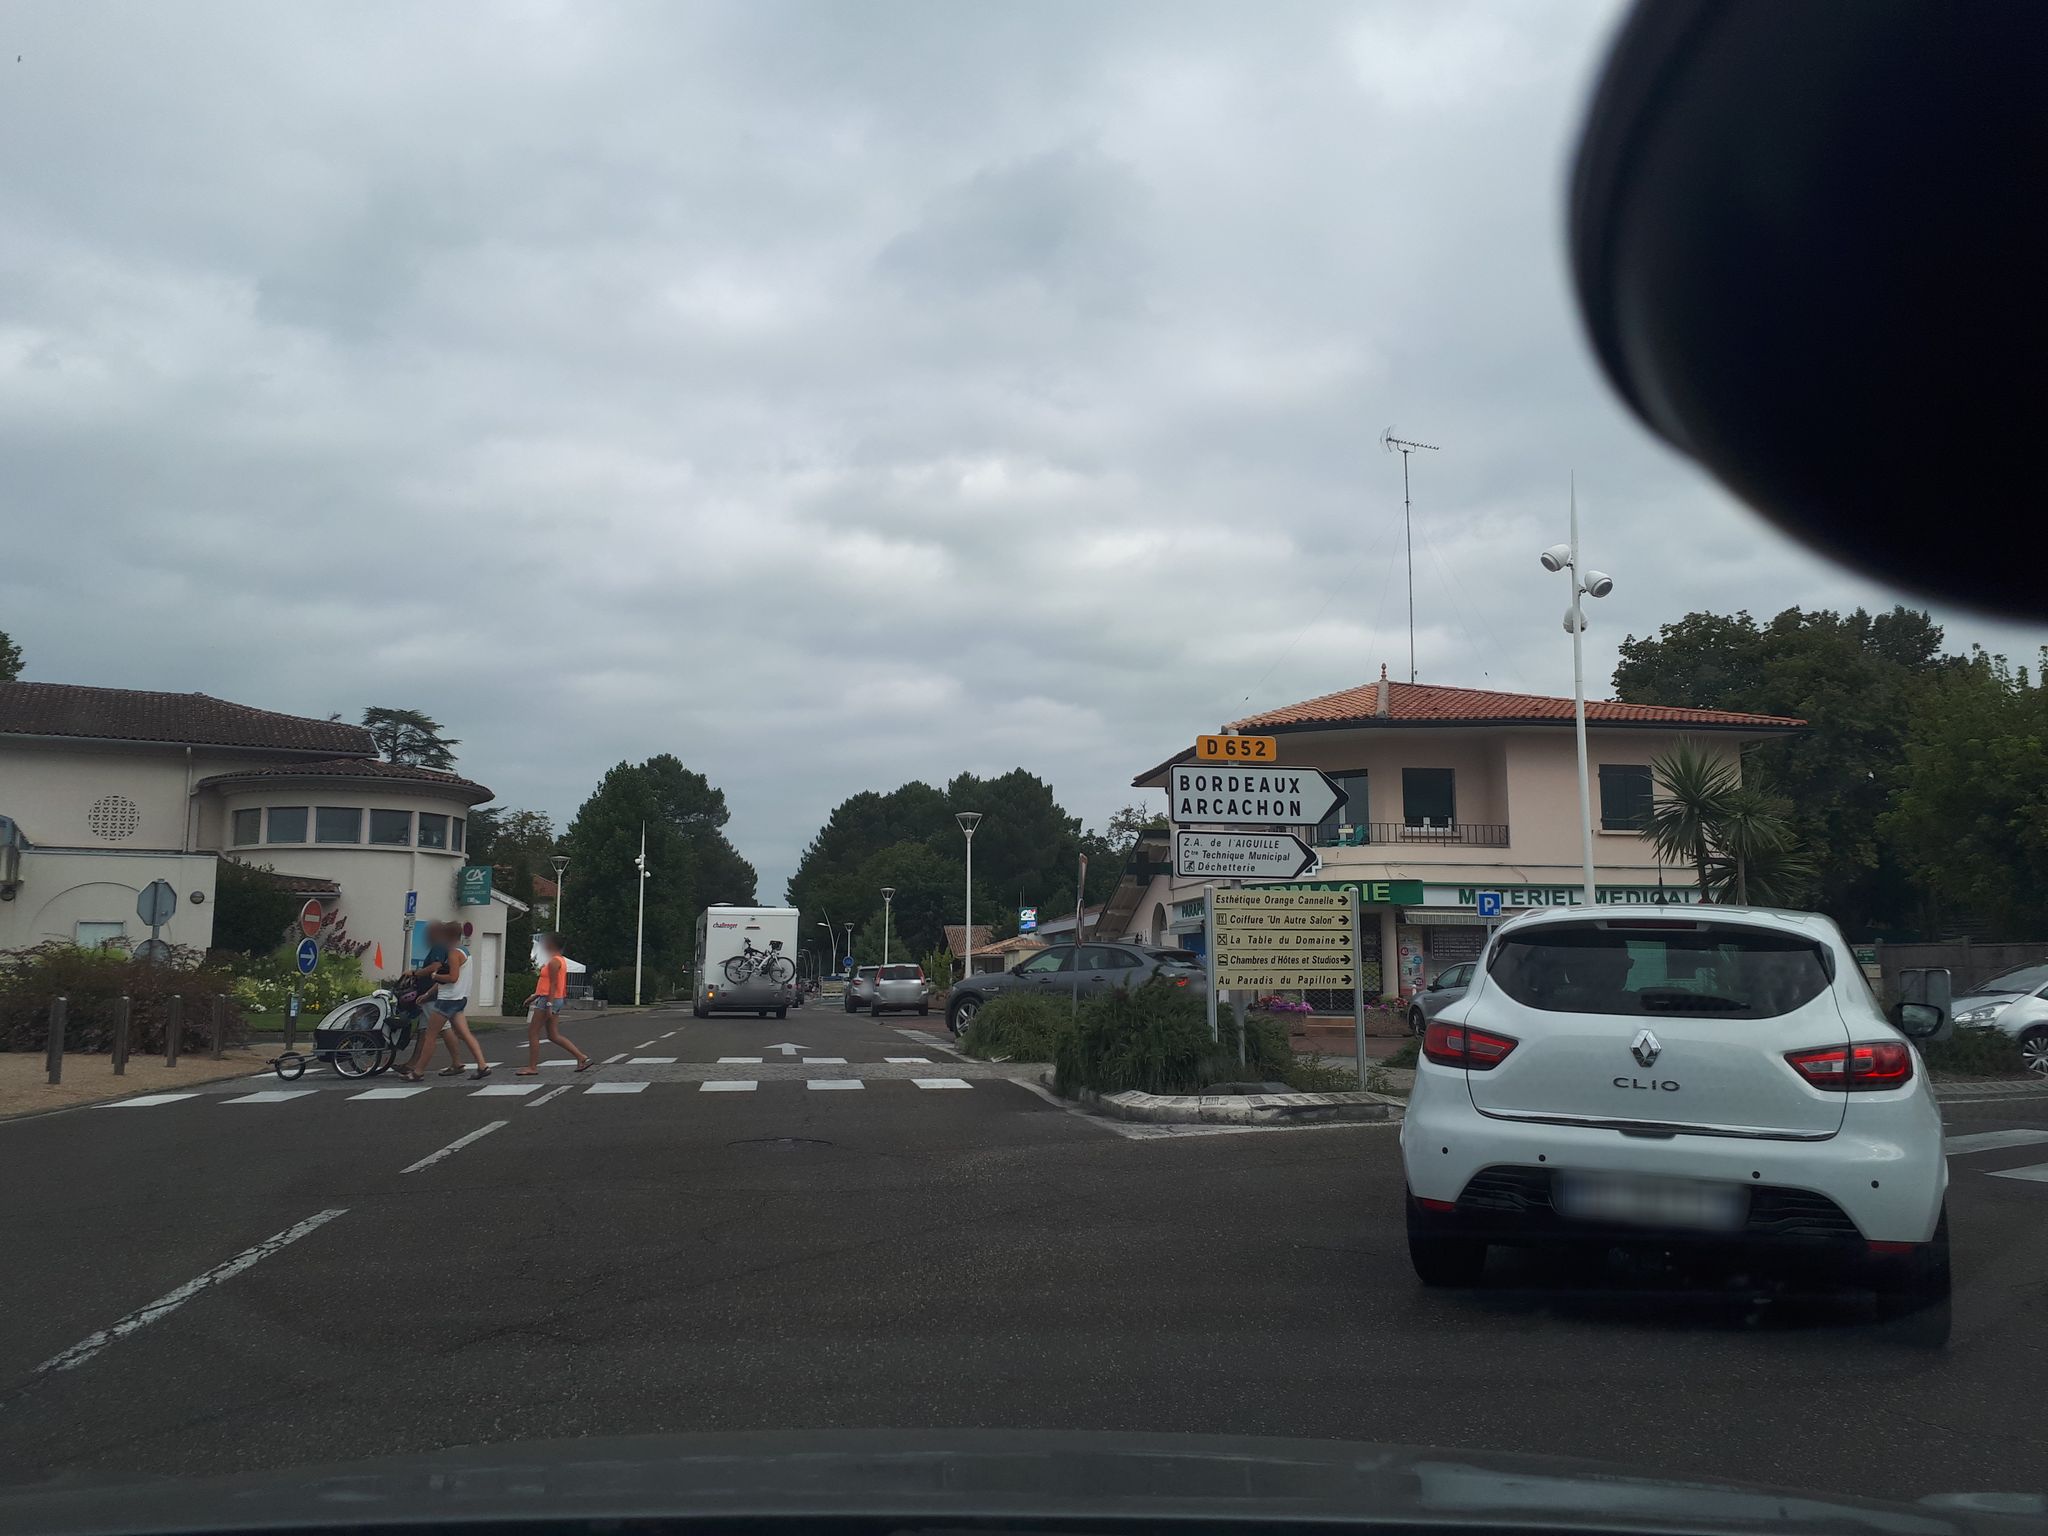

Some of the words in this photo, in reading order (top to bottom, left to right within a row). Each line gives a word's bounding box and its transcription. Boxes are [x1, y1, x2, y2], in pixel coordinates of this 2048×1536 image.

[1207, 739, 1218, 755] D
[1225, 740, 1266, 756] 652
[1179, 775, 1300, 794] BORDEAUX
[1181, 798, 1301, 816] ARCACHON
[1183, 837, 1203, 847] Z.A.
[1210, 838, 1222, 847] de
[1228, 838, 1280, 849] l'AIGUILLE
[1202, 850, 1245, 861] Technique
[1248, 851, 1290, 863] Municipal
[1197, 861, 1256, 872] Déchetterie
[1215, 894, 1260, 906] Esthétique
[1264, 895, 1294, 906] Orange
[1297, 895, 1334, 905] Cannelle
[1458, 888, 1582, 906] MTERIEL
[1229, 914, 1264, 924] Coiffure
[1283, 915, 1306, 925] Autre
[1230, 935, 1241, 944] La
[1247, 935, 1272, 945] Table
[1278, 935, 1290, 945] du
[1295, 935, 1336, 945] Domaine
[1230, 955, 1268, 965] Chambres
[1301, 956, 1310, 965] et
[1311, 955, 1340, 965] Studios
[1218, 975, 1231, 985] Au
[1237, 975, 1274, 985] Paradis
[1280, 975, 1291, 985] du
[1297, 975, 1337, 986] Papillon
[1612, 1077, 1681, 1092] CLIO
